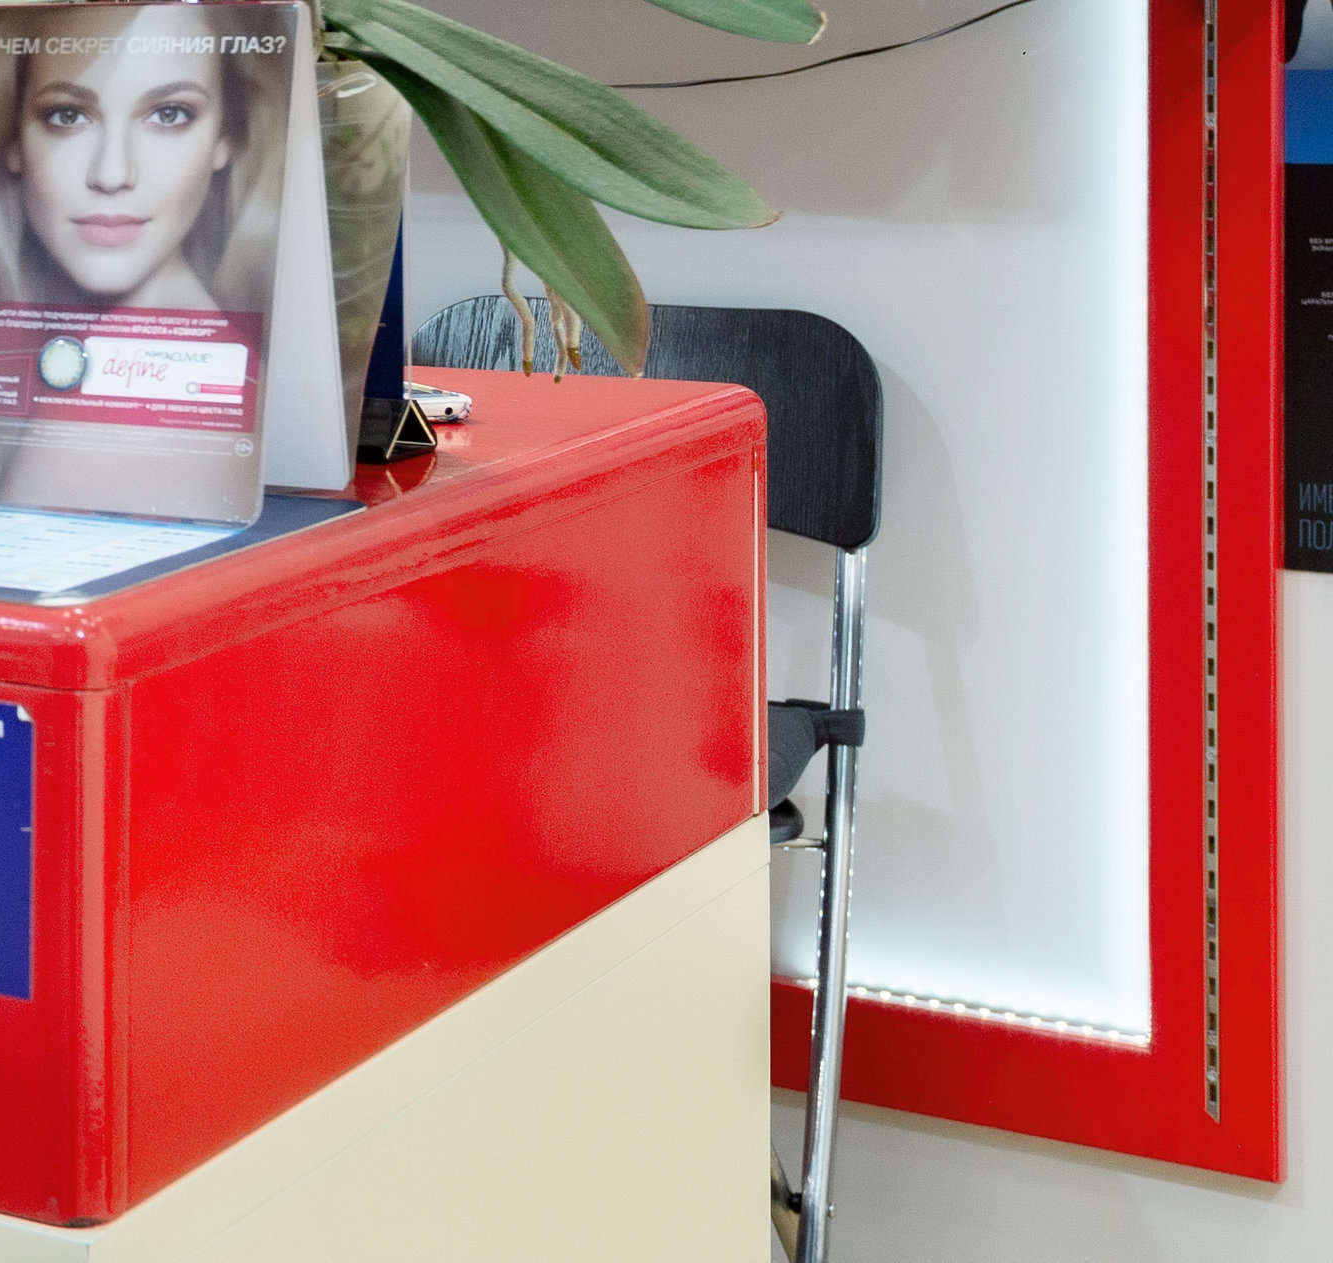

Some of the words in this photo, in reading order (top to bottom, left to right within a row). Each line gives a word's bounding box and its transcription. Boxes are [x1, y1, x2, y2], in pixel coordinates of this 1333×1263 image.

[45, 37, 122, 54] СЕКРЕТ
[127, 37, 215, 55] СИЯНИЯ
[220, 37, 287, 54] ГЛАЗ?
[103, 348, 169, 388] define
